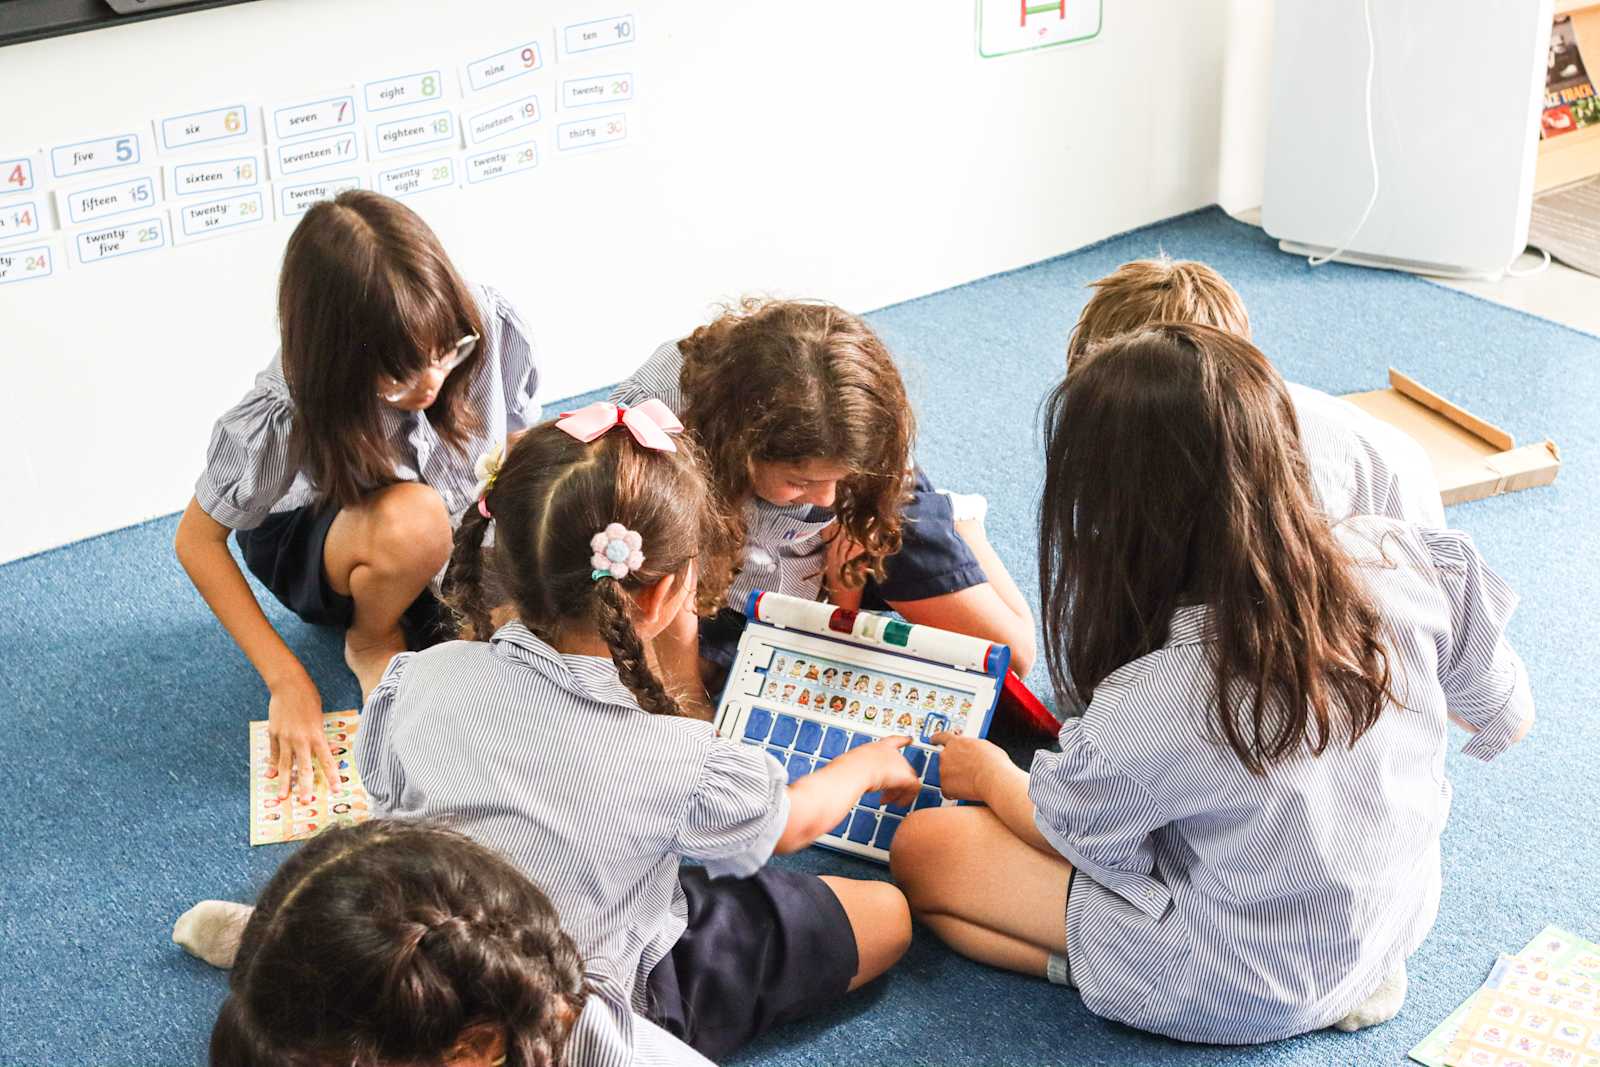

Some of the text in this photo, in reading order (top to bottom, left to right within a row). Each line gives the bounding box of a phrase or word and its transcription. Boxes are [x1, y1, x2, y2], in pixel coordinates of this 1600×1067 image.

[582, 22, 632, 42] ten 10
[484, 48, 536, 78] nine 9
[380, 76, 435, 100] eight 8
[572, 81, 629, 97] twenty 20
[289, 101, 349, 126] seven 7
[185, 111, 241, 135] six 6
[383, 118, 449, 141] eighteen 18
[476, 115, 514, 133] nineteen
[568, 121, 623, 140] thirty 30
[73, 139, 133, 165] five 5
[283, 138, 351, 164] seventeen 17
[516, 149, 534, 164] 29
[8, 164, 26, 186] 4
[185, 163, 252, 184] sixteen 16
[431, 165, 450, 180] 28
[483, 166, 503, 177] nine
[394, 179, 420, 192] eight
[81, 185, 149, 212] fifteen 15
[239, 200, 257, 217] 26
[12, 211, 32, 227] 14
[204, 217, 220, 227] six
[137, 226, 158, 243] 25
[99, 243, 120, 257] five
[25, 255, 46, 271] 24
